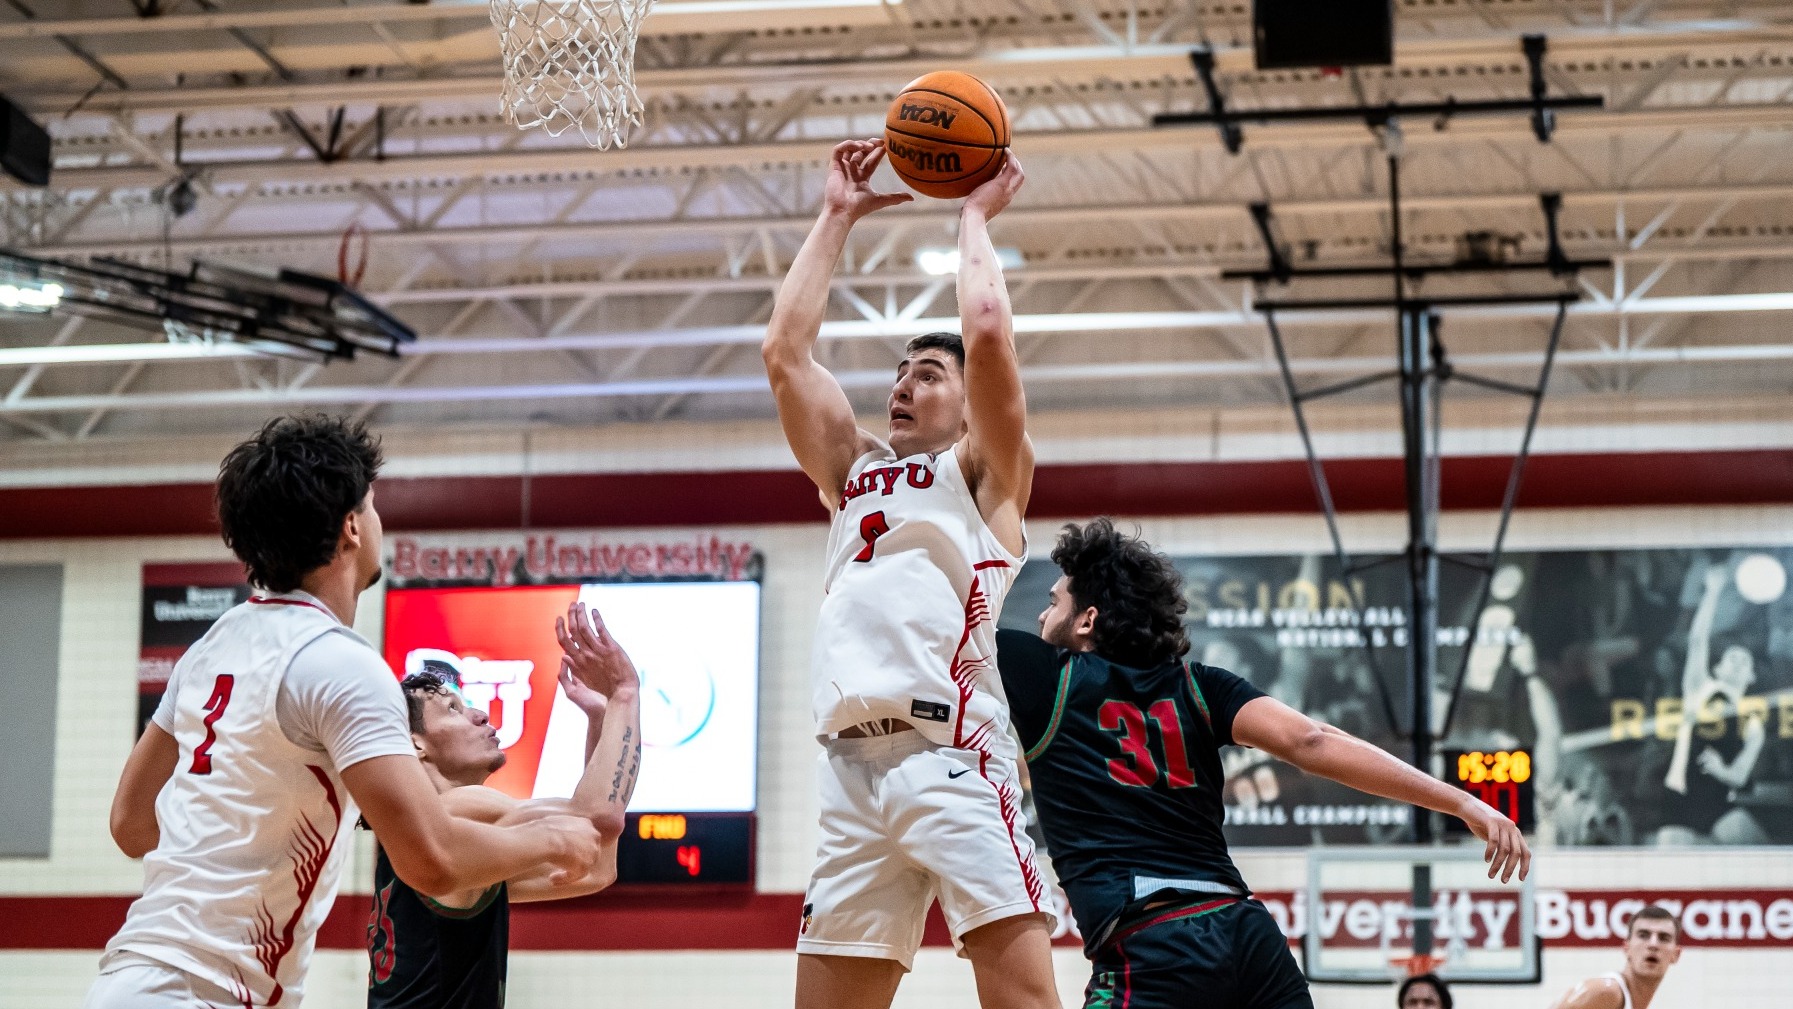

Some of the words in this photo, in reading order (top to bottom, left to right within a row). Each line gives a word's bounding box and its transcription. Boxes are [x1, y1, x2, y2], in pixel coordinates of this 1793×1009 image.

[899, 102, 957, 130] NCAA
[888, 136, 963, 173] Wilson
[393, 535, 518, 587] Barry
[525, 531, 752, 580] University
[187, 674, 235, 775] 2
[1097, 698, 1198, 789] 31
[676, 845, 701, 877] 4
